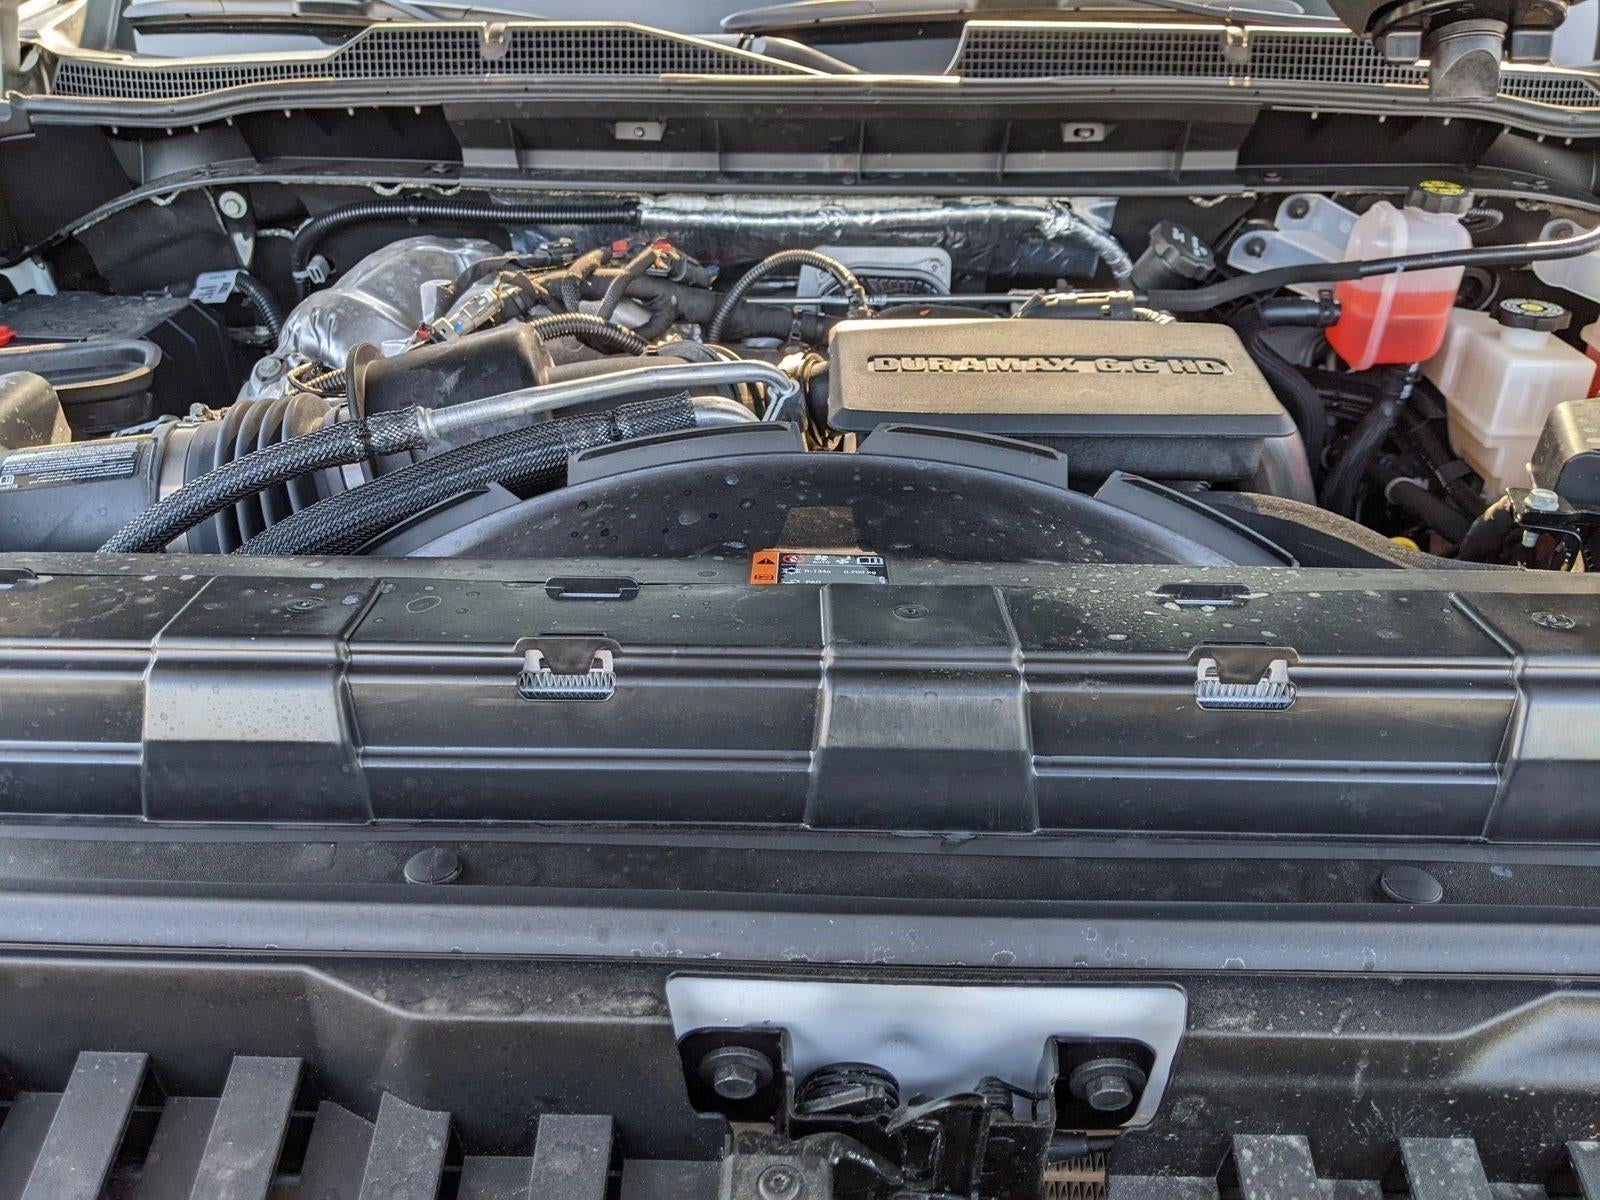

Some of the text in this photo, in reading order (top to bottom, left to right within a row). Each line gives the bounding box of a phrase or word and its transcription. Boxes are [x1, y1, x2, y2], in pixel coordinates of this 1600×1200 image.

[874, 357, 1224, 375] DURAMAX 6.6 HD
